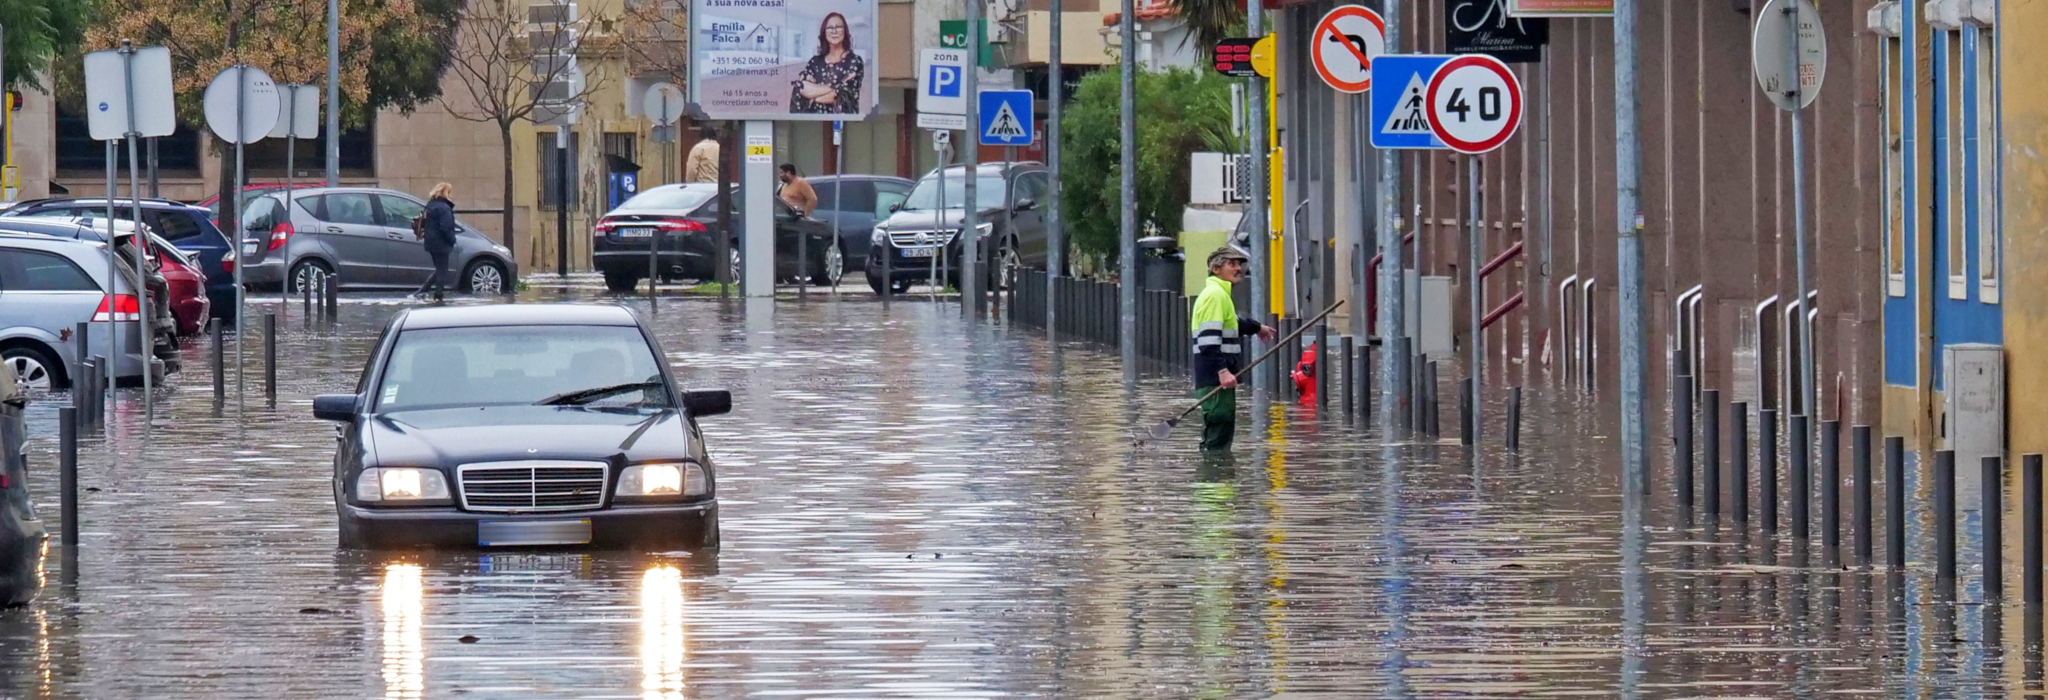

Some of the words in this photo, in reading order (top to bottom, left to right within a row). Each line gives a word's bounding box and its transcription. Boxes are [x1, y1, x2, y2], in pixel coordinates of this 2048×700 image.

[711, 22, 745, 32] Emília
[711, 34, 740, 43] Falca
[1471, 31, 1515, 45] Marina
[712, 57, 730, 65] +351
[732, 57, 747, 65] 962
[749, 57, 763, 65] 060
[765, 57, 779, 65] 944
[711, 68, 779, 77] efalca@remax.pt
[935, 66, 955, 95] P
[723, 89, 733, 97] Há
[735, 89, 743, 97] 15
[712, 99, 751, 107] concretizar
[752, 99, 779, 107] sonhos
[1446, 86, 1501, 122] 40
[754, 147, 765, 155] 24
[624, 176, 633, 188] P
